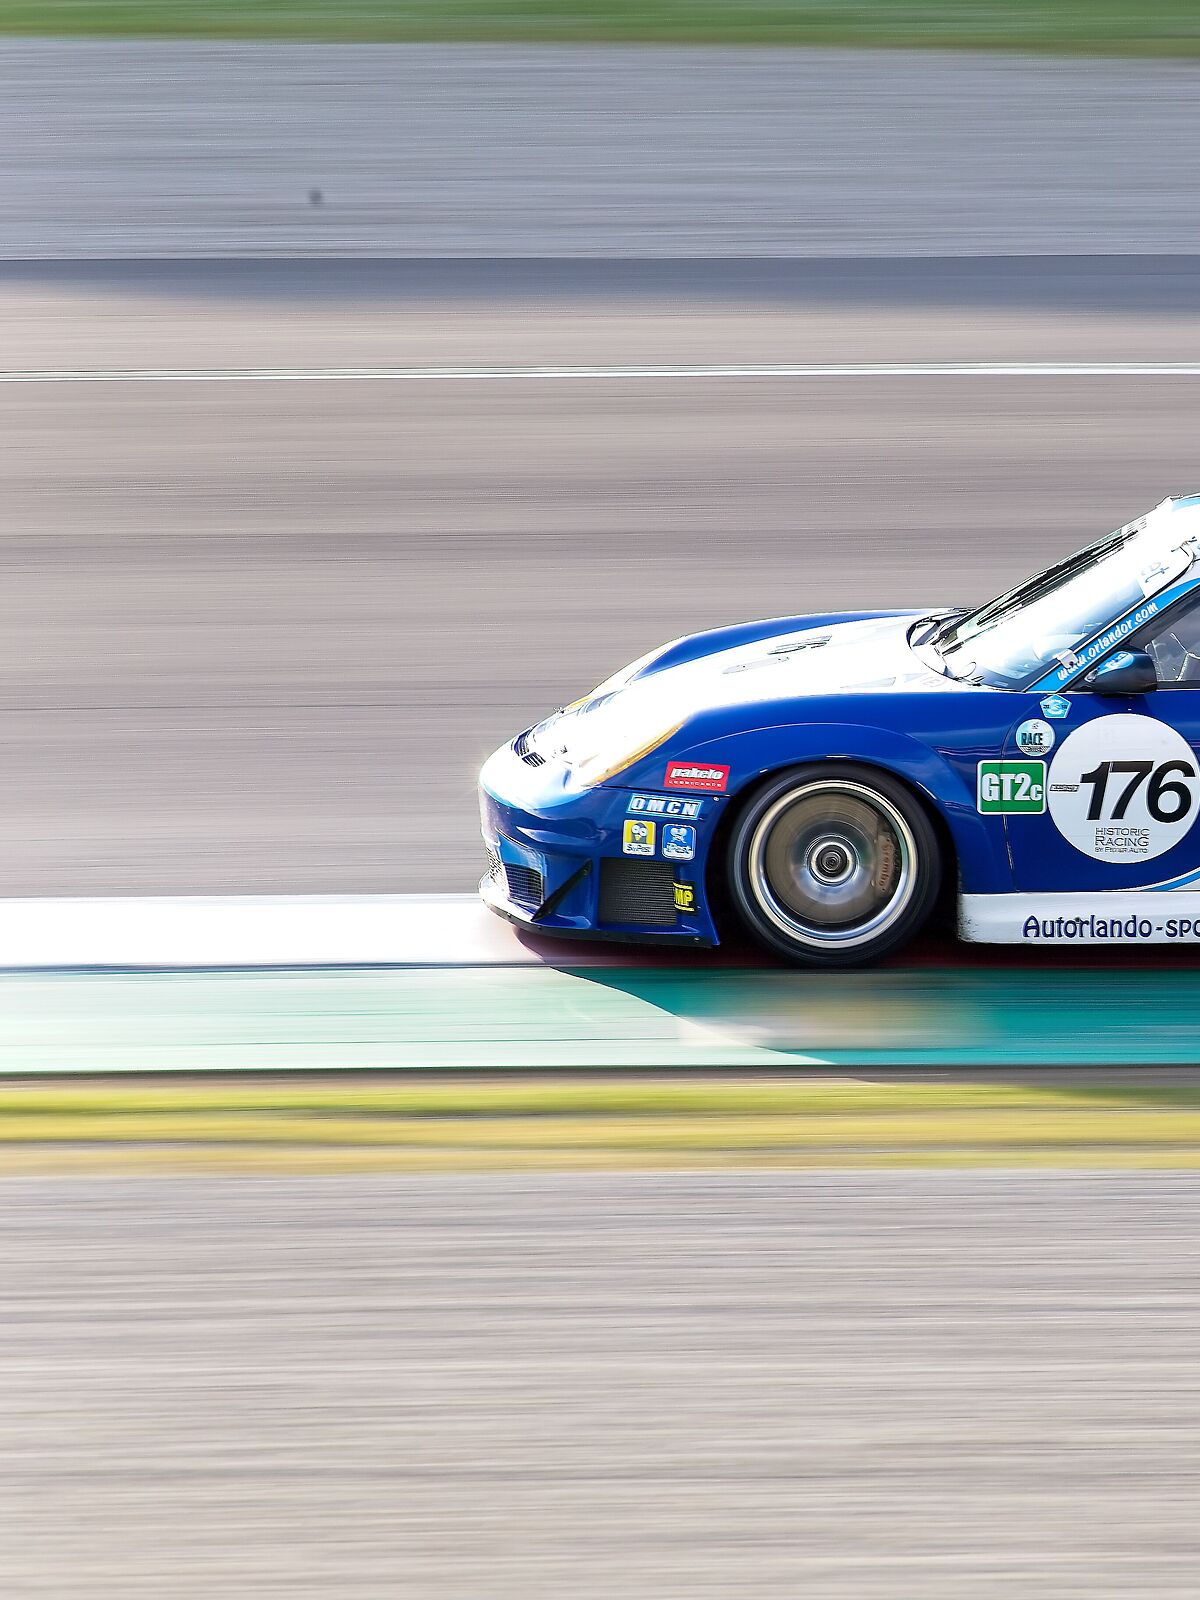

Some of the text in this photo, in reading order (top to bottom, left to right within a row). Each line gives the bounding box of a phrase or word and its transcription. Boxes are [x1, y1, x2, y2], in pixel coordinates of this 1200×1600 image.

[1021, 732, 1043, 746] RACE
[669, 767, 725, 781] pakelo
[981, 773, 1044, 801] GT2c
[1079, 760, 1197, 824] 176
[631, 797, 697, 816] OMCN
[1094, 827, 1151, 837] HISTORIC
[1094, 835, 1151, 847] RACING
